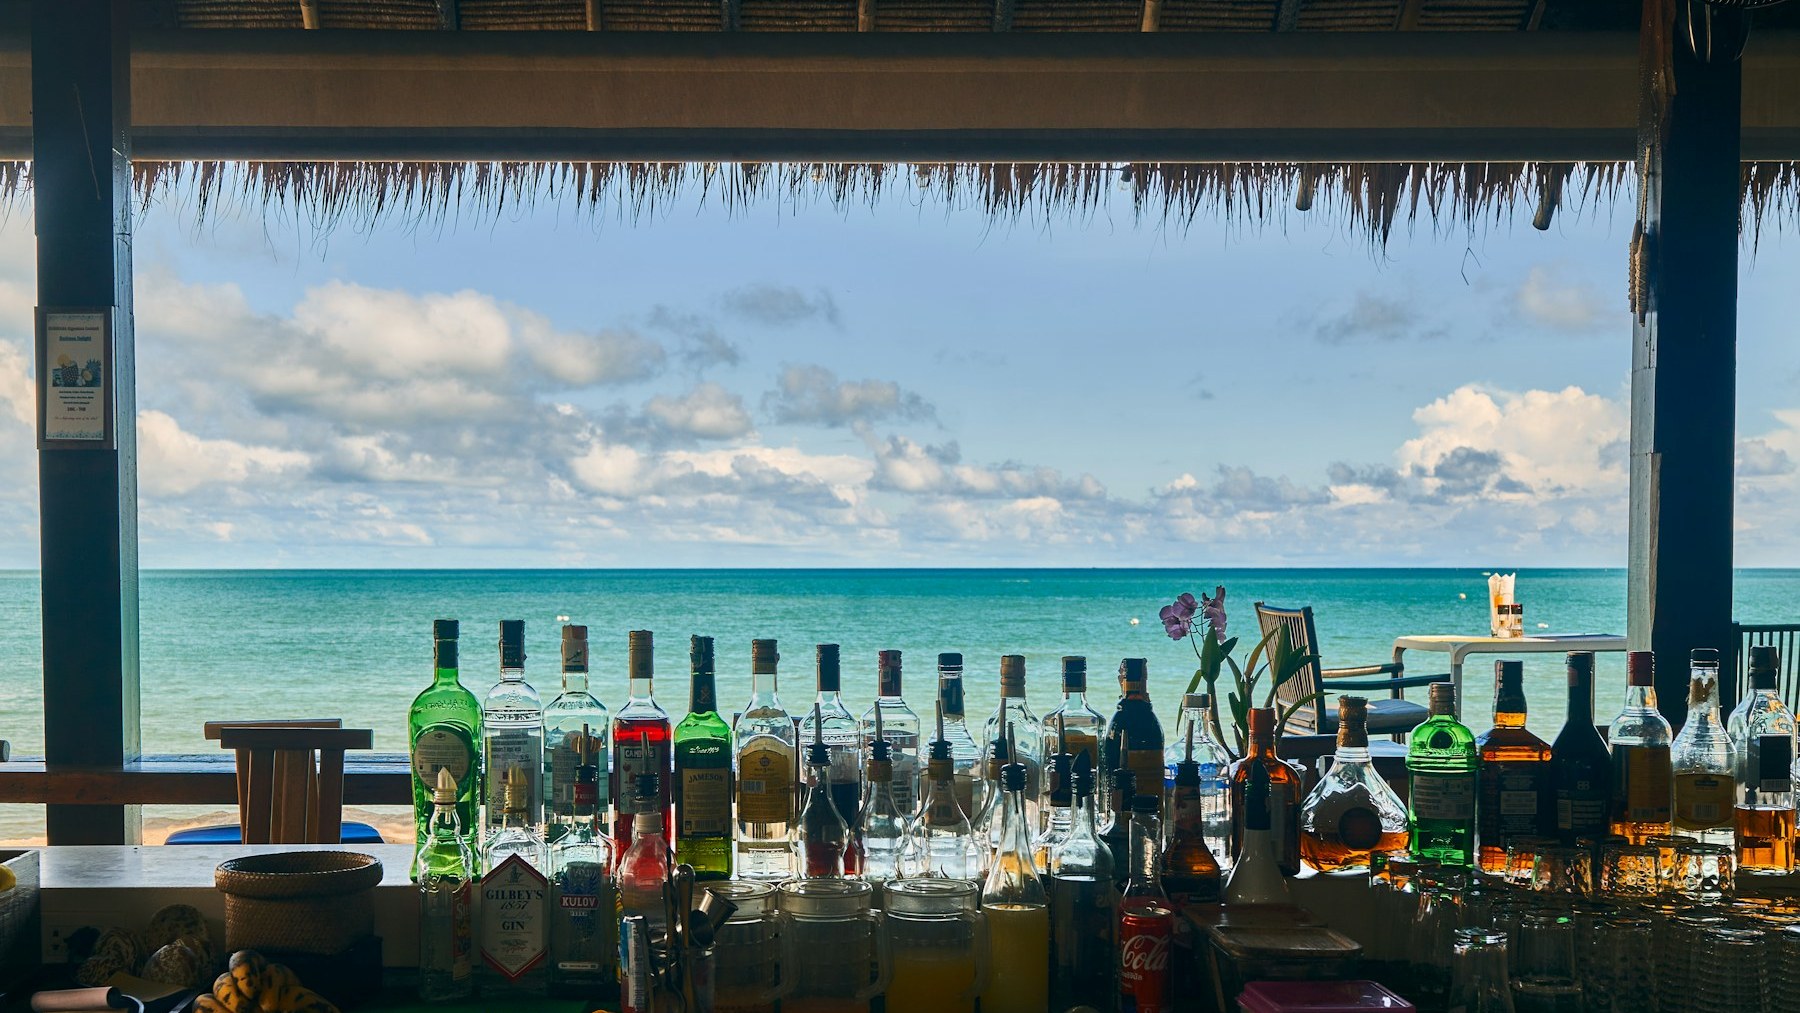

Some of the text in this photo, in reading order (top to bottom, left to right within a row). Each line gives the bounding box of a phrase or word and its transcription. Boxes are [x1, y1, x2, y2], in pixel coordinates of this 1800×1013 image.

[688, 773, 724, 783] JAMESON
[485, 889, 544, 900] GILBEY'S
[500, 900, 529, 911] 1857
[561, 896, 597, 907] KULOV
[502, 921, 525, 931] GIN
[1122, 934, 1169, 971] Cola
